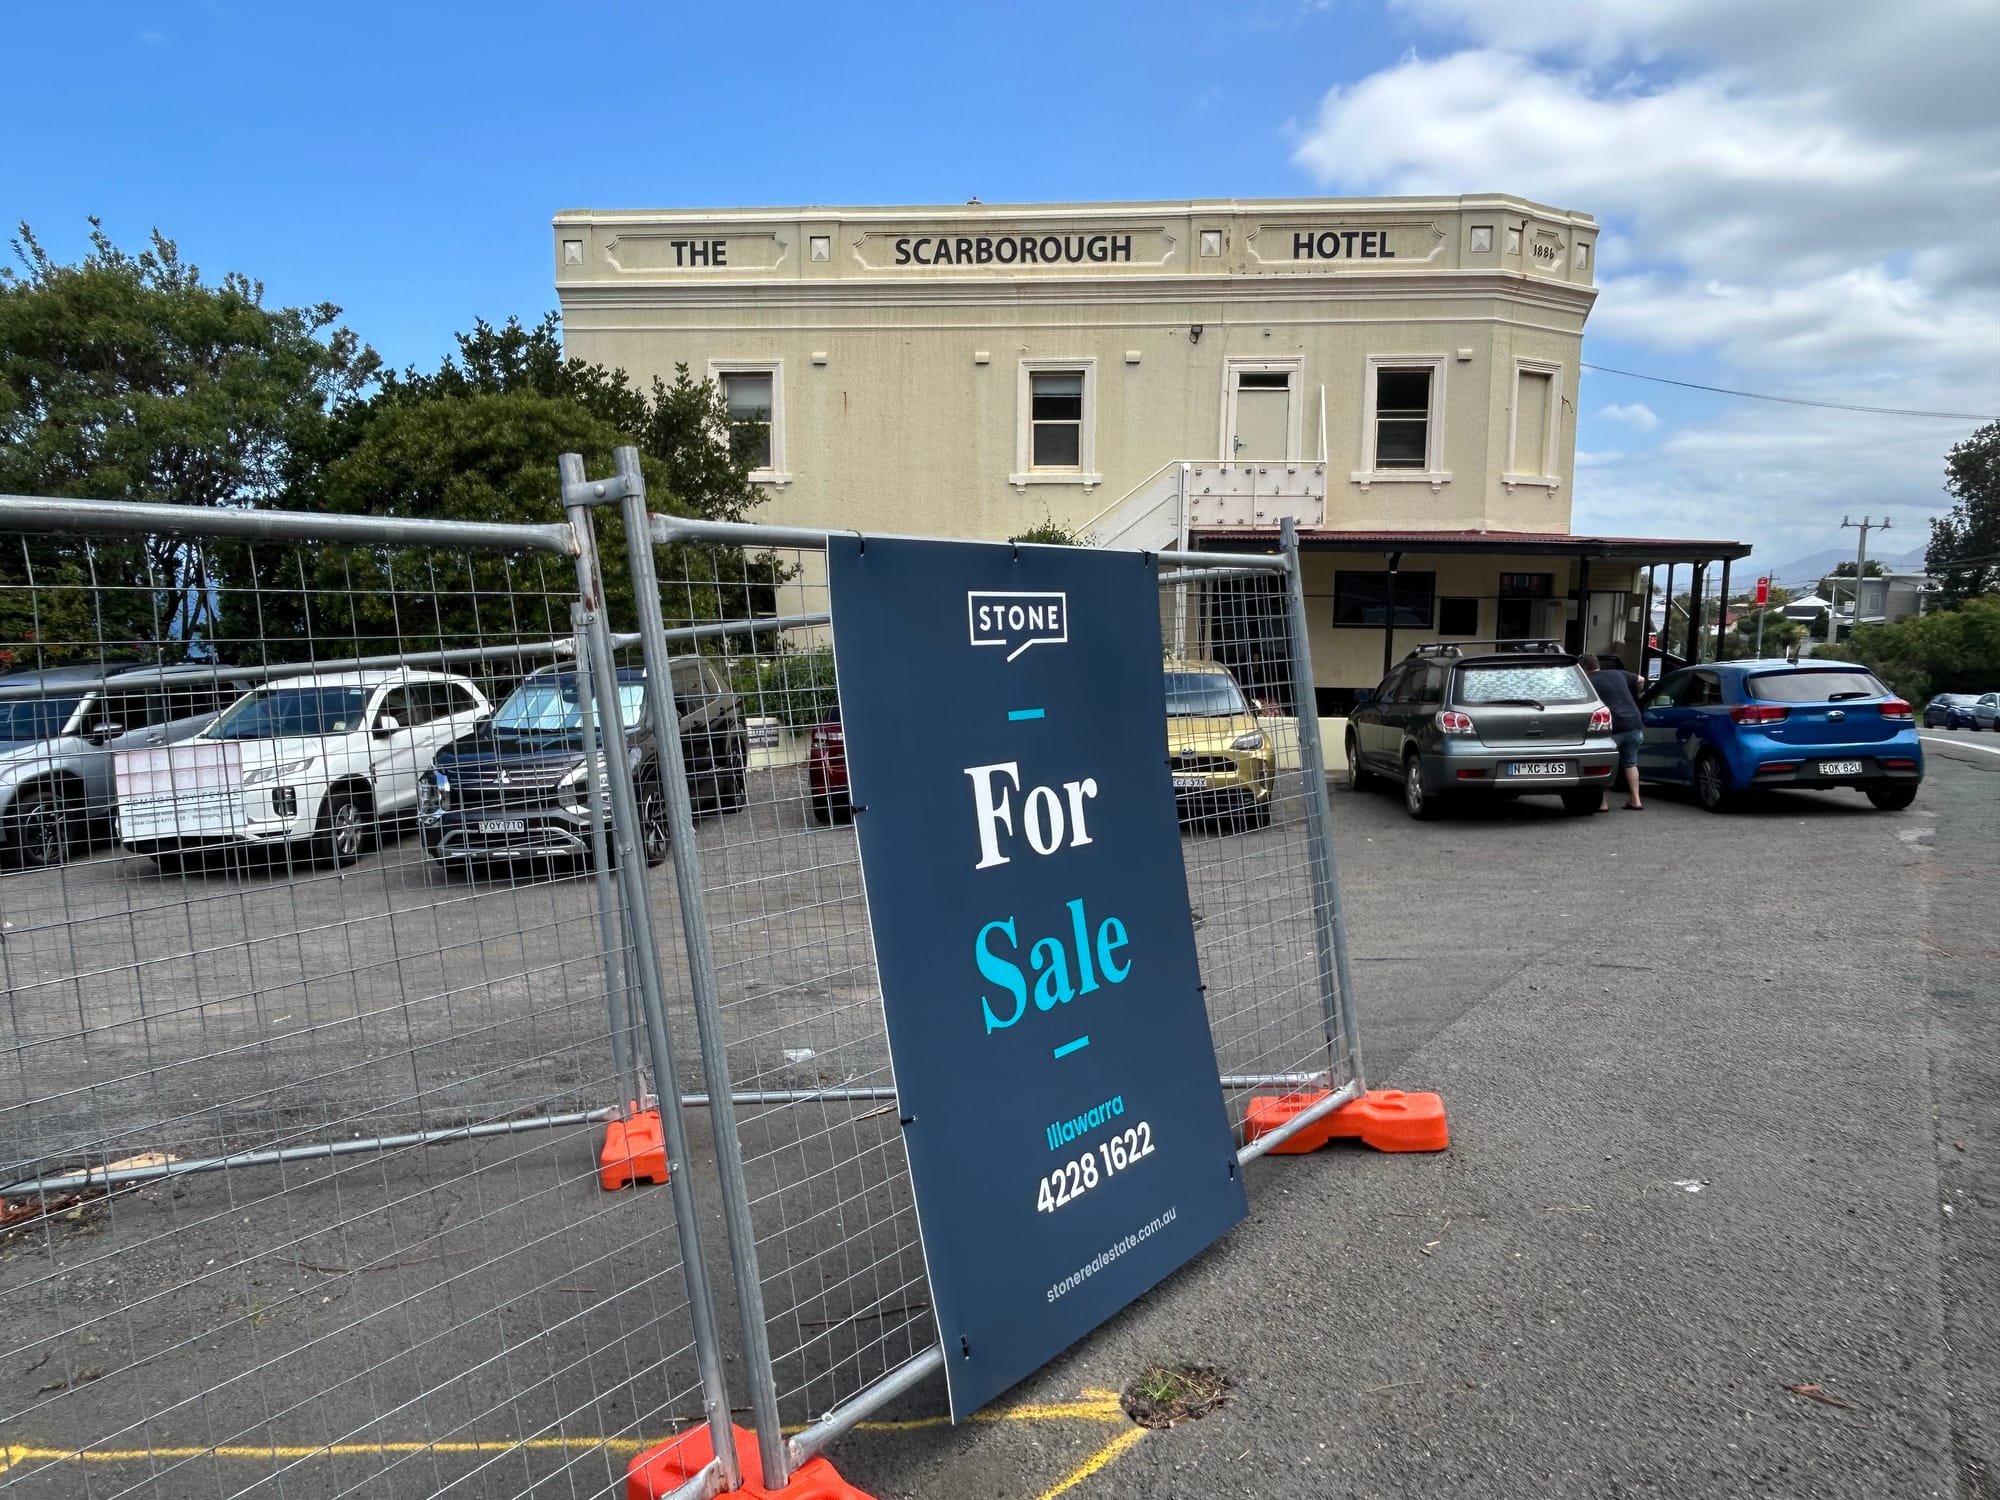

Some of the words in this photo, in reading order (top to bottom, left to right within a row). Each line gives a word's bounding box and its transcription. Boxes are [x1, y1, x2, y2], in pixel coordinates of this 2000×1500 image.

[670, 240, 727, 267] THE
[895, 235, 1131, 265] SCARBOROUGH
[1293, 231, 1395, 259] HOTEL
[1533, 244, 1555, 260] 1886
[979, 605, 1059, 631] STONE
[964, 761, 1098, 870] For
[975, 898, 1132, 1035] Sale
[1046, 1096, 1125, 1151] Illawarra
[1037, 1152, 1099, 1213] 4228
[1099, 1121, 1155, 1177] 1622
[1047, 1206, 1177, 1303] stonerealestate.com.au
